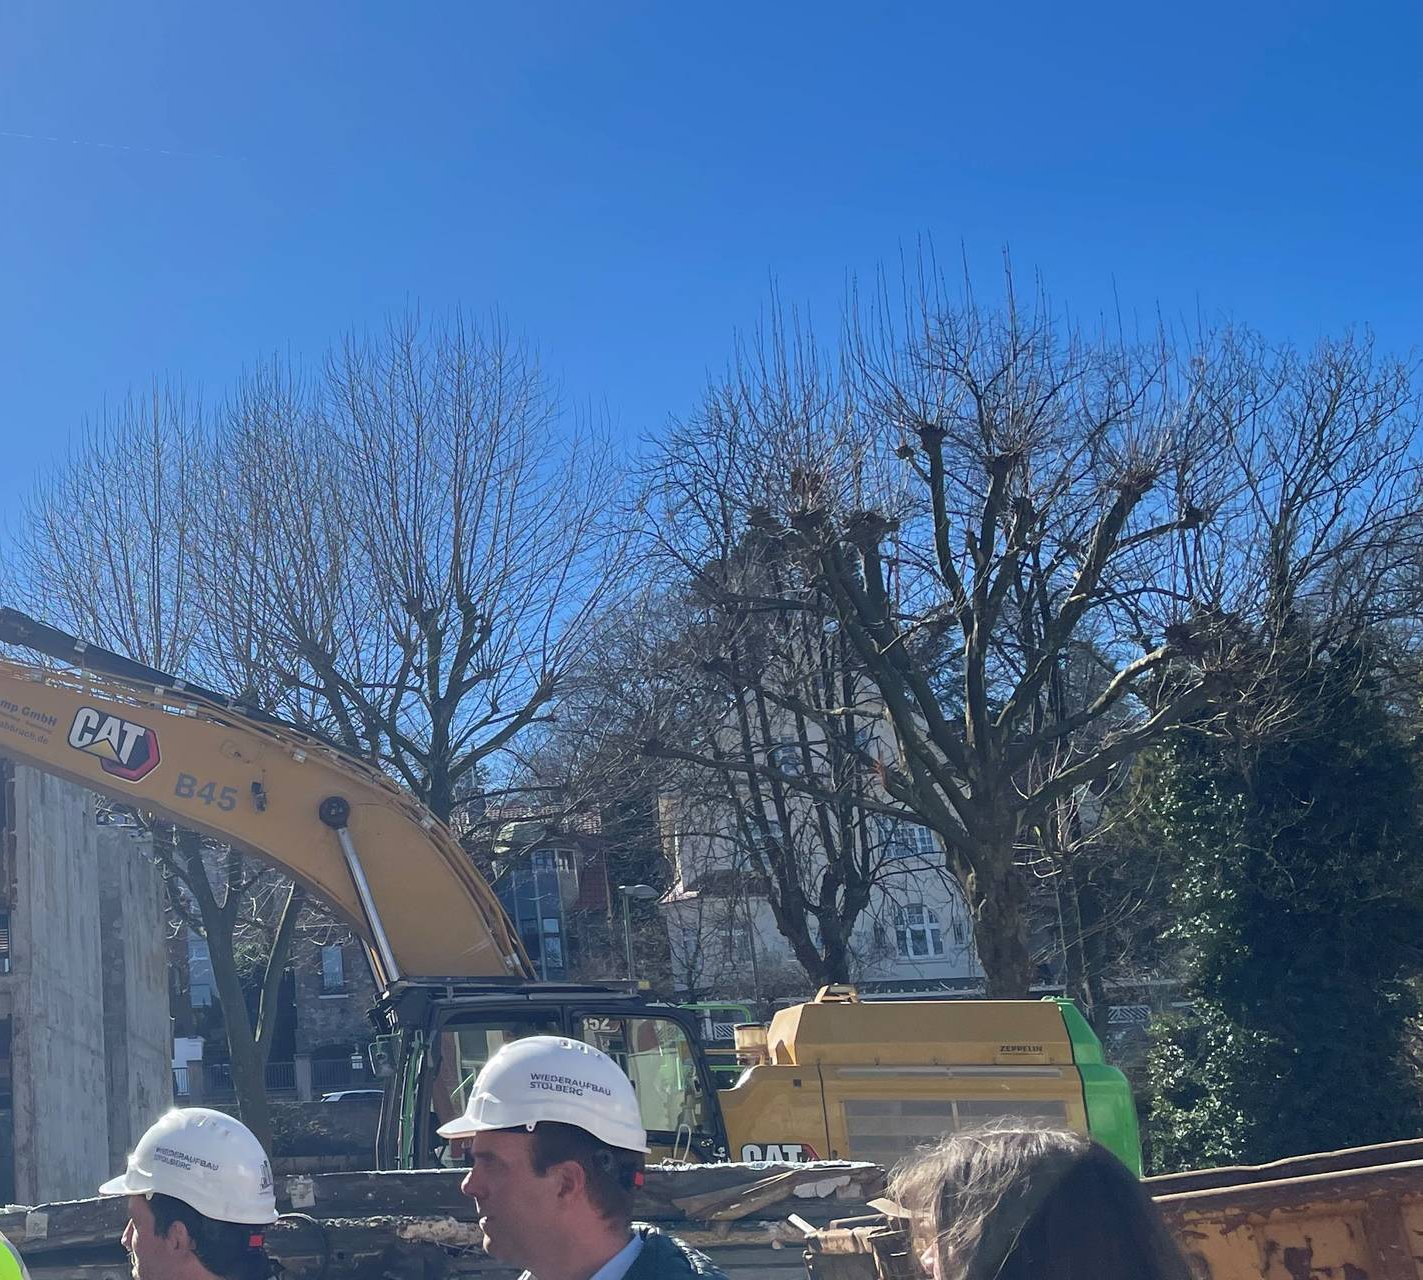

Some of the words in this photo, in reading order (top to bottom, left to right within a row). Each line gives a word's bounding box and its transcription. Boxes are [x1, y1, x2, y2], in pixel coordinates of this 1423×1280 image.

[21, 706, 58, 727] GmbH
[69, 707, 146, 765] CAT
[174, 771, 240, 811] B45
[529, 1081, 583, 1097] STOLBERG
[530, 1072, 611, 1096] WIEDERAUFBAU
